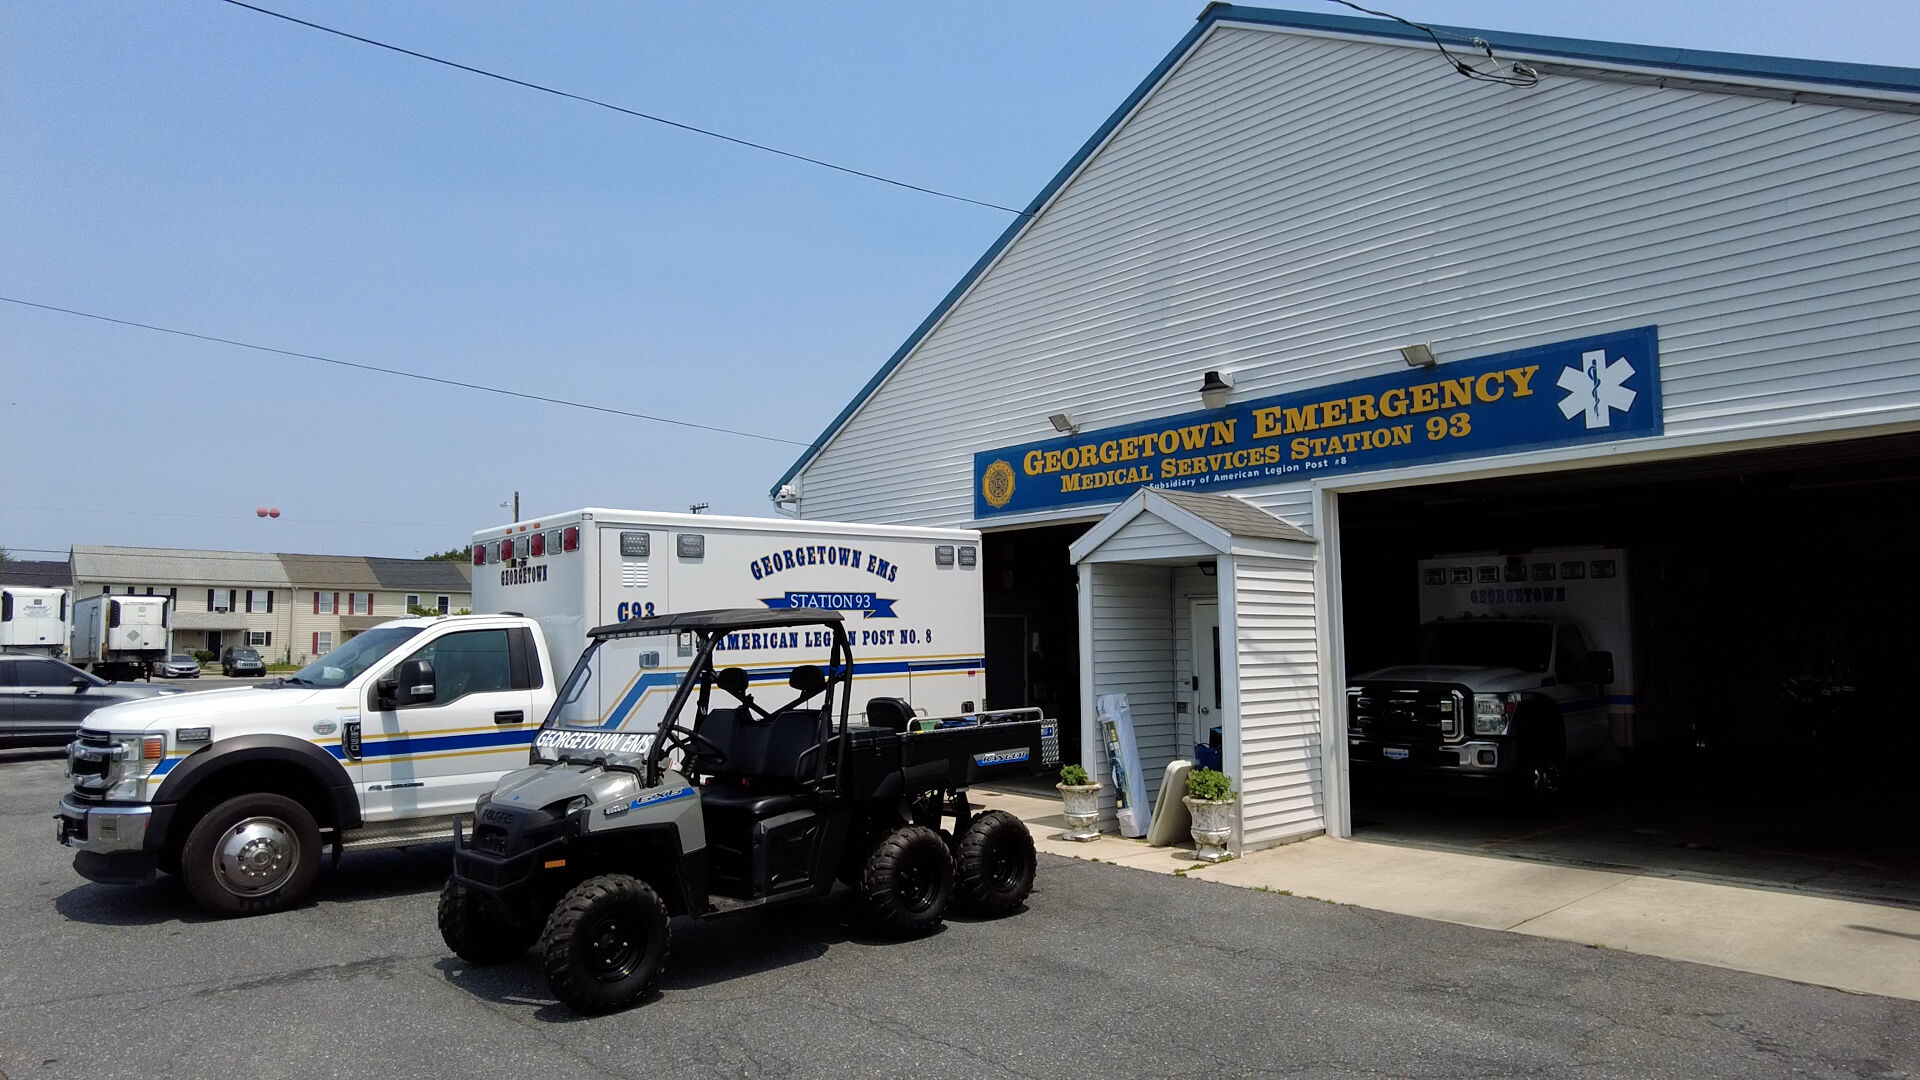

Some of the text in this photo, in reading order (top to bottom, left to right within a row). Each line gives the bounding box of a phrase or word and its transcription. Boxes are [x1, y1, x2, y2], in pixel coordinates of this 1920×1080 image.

[1023, 365, 1540, 476] GEORGETOWN EMERGENCY
[1061, 412, 1472, 493] MEDICAL SERVICES STATION 93
[1149, 456, 1347, 490] Subsidiary of American Legion Post #8
[501, 564, 548, 587] GEORGETOWN
[750, 546, 898, 583] GEORGETOWN EMS
[790, 593, 871, 609] STATION 93
[1470, 587, 1566, 604] GEORGETOWN
[716, 628, 932, 651] AMERICAN LEGN POST NO. 8
[535, 730, 656, 753] GEORGETOWN EMS
